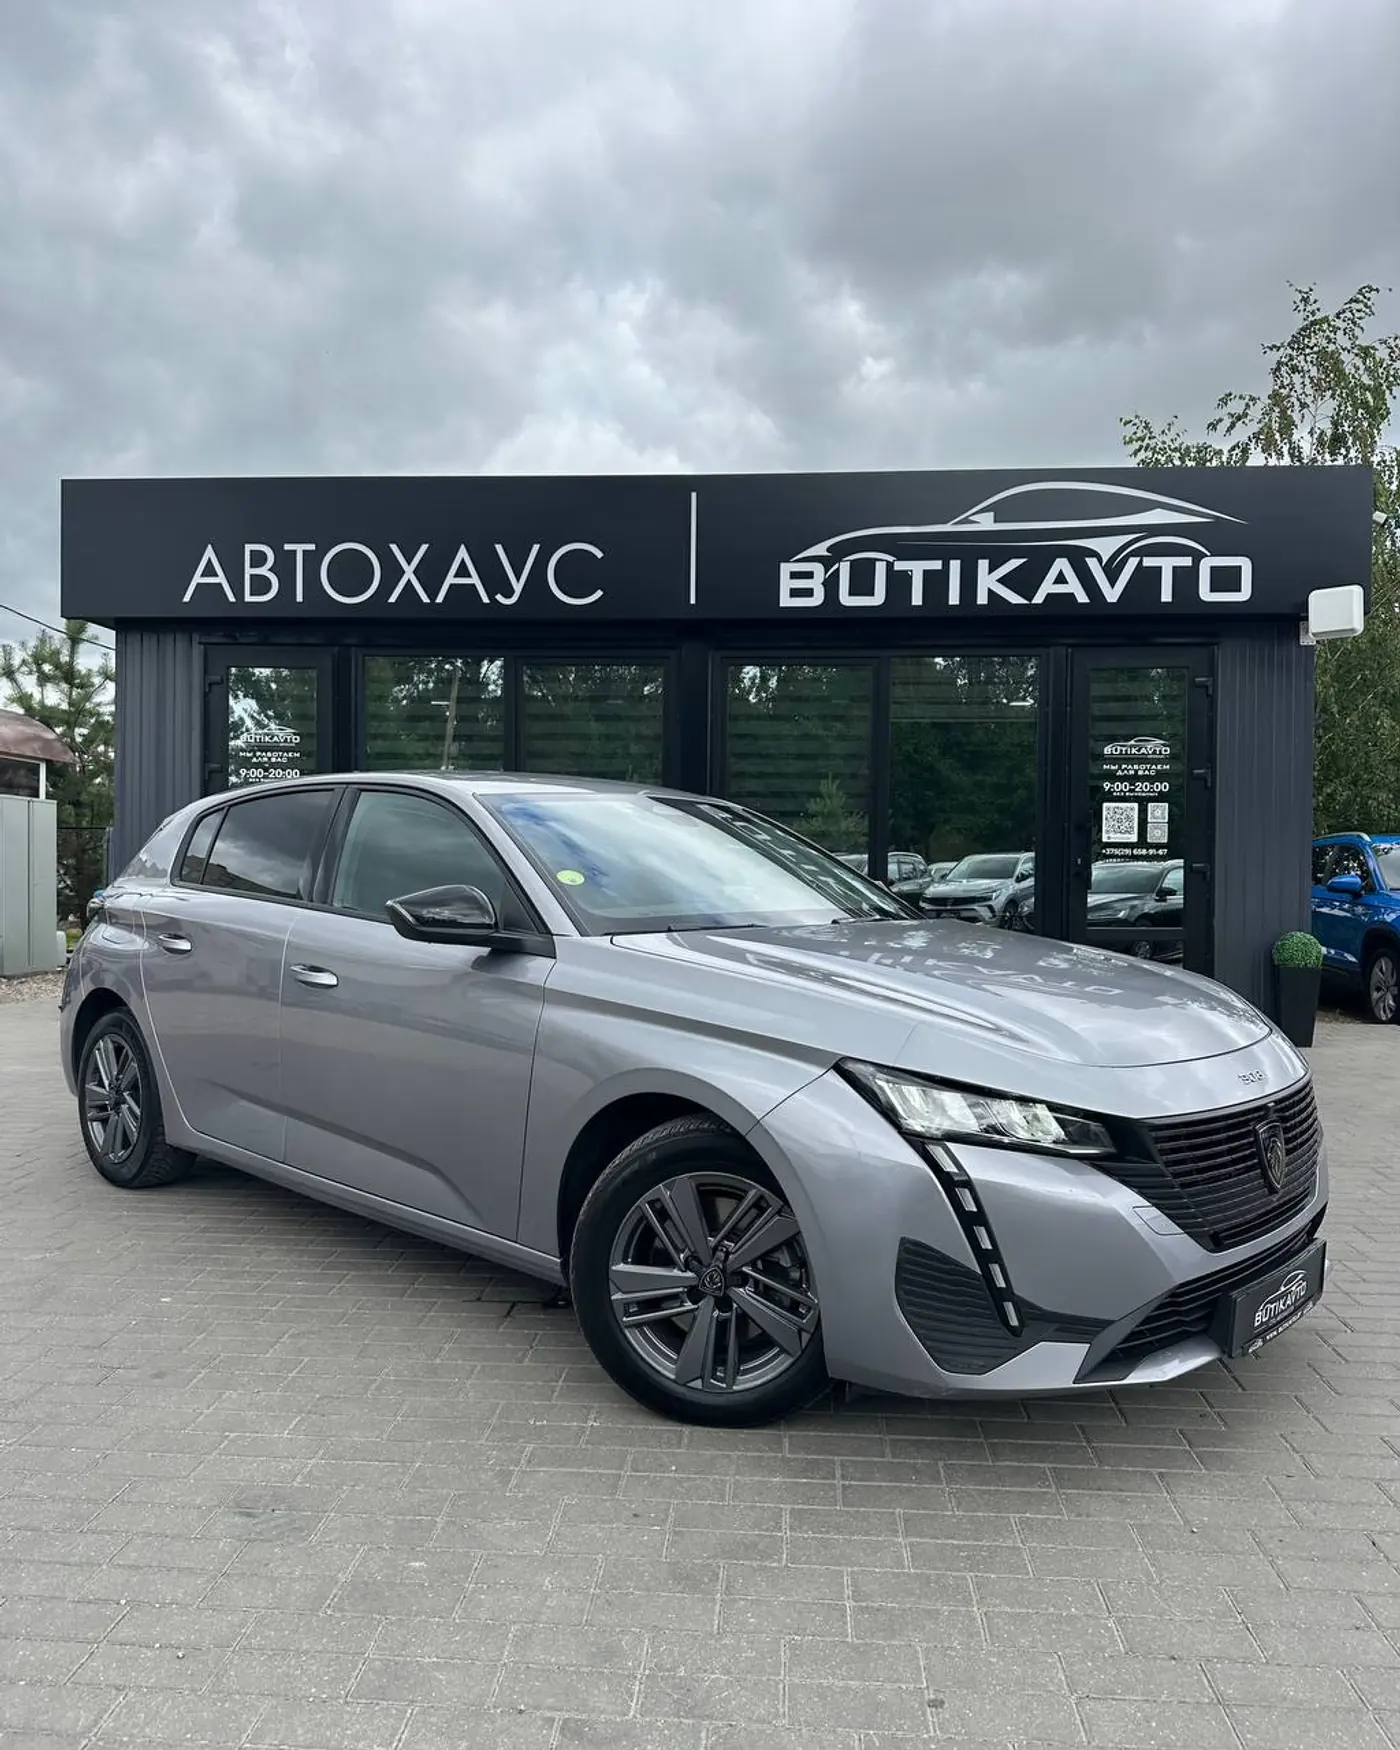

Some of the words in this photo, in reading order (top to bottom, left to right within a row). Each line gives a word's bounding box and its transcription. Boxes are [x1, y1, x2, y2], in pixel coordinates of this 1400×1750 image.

[182, 542, 605, 606] АВТОХАУС
[779, 555, 1253, 608] BUTIKAVTO
[1103, 746, 1170, 755] BUTIKAVTO
[239, 768, 301, 779] 9:00-20:00
[1103, 781, 1170, 792] 9:00-20:00
[1254, 1281, 1307, 1328] BUTIKAVTO
